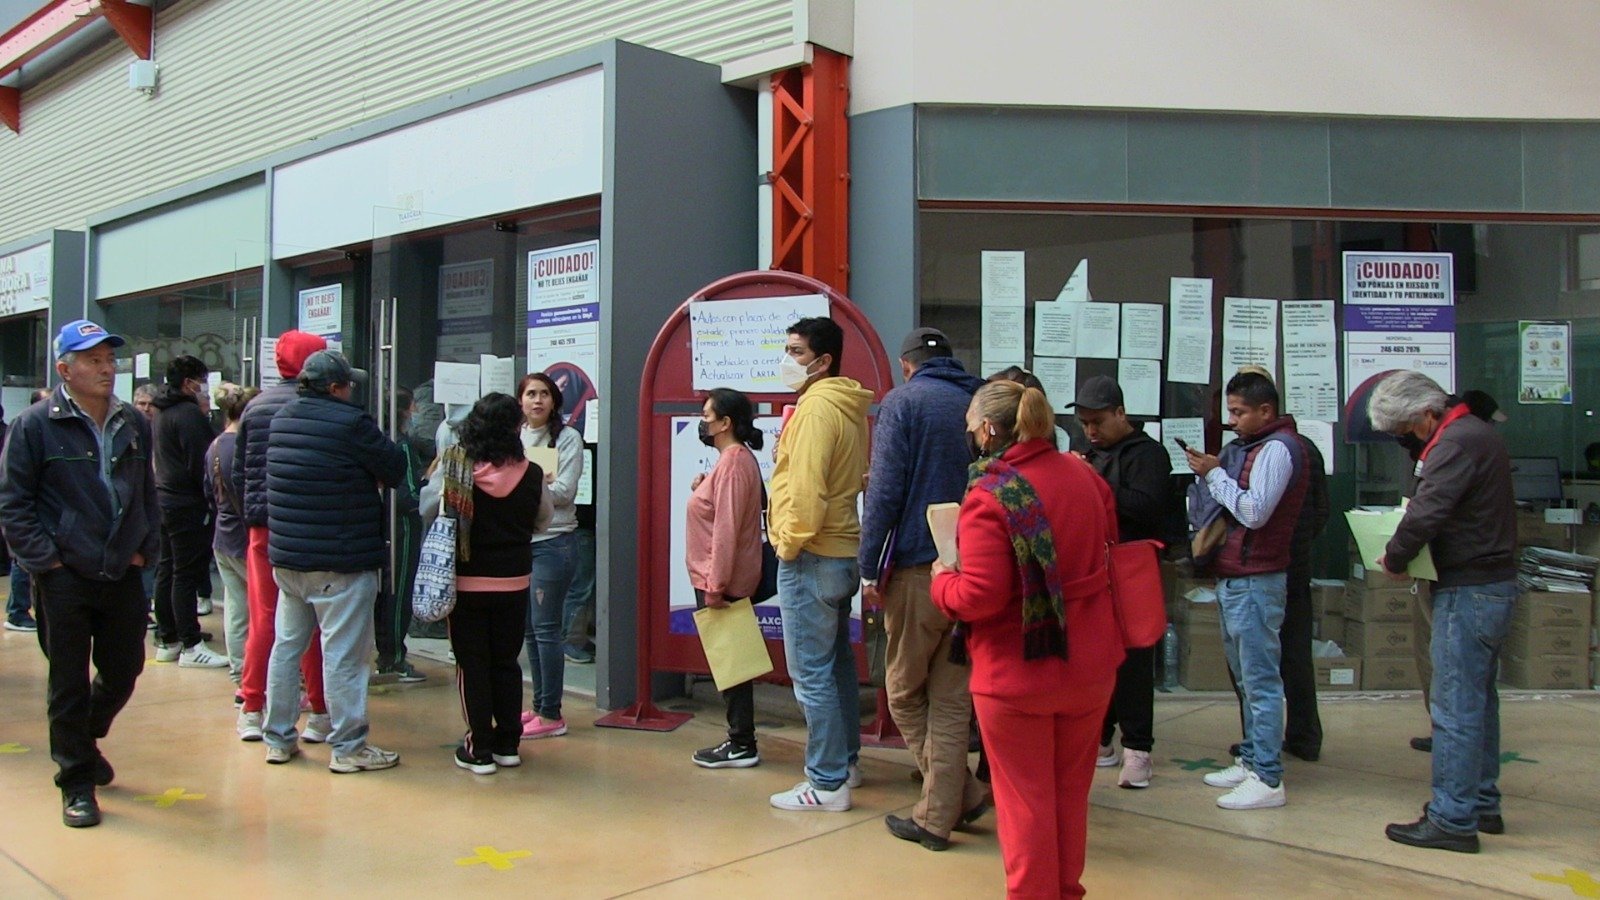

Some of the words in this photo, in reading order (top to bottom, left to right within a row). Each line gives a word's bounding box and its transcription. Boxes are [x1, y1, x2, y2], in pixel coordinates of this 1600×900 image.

[533, 252, 593, 280] ¡CUIDADO!
[1356, 261, 1440, 280] ¡CUIDADO!
[1357, 281, 1366, 289] NO
[1368, 281, 1394, 289] PONGAS
[1396, 281, 1404, 289] EN
[1405, 281, 1430, 289] RIESGO
[1431, 281, 1440, 289] TU
[1352, 291, 1387, 299] IDENTIDAD
[1394, 291, 1403, 299] TU
[1404, 291, 1445, 299] PATRIMONIO
[769, 312, 781, 321] de
[761, 323, 786, 335] valida
[700, 353, 711, 366] En
